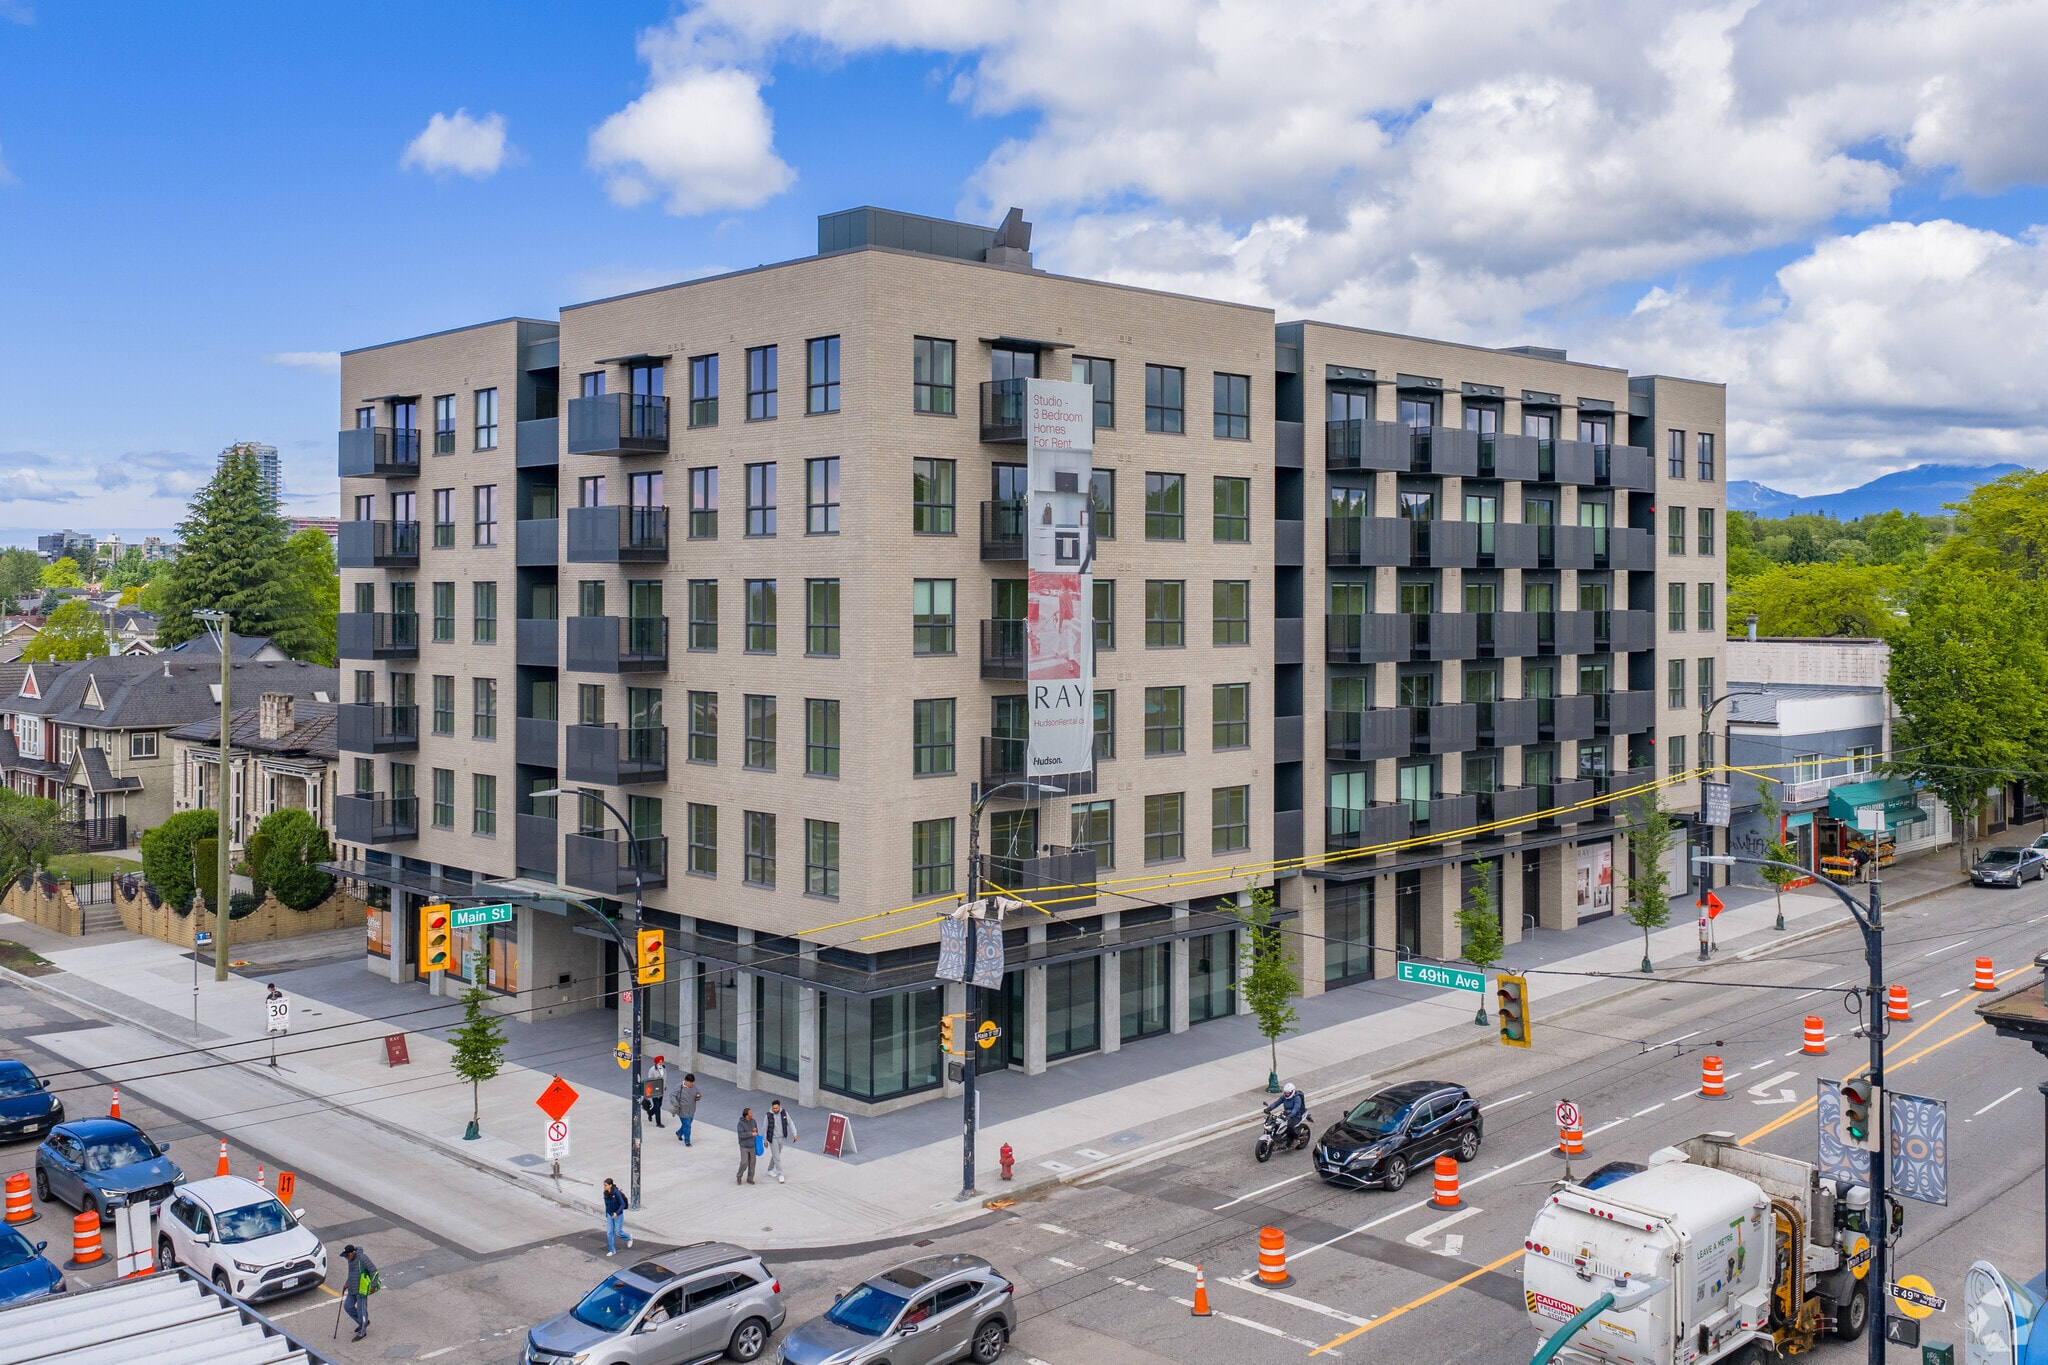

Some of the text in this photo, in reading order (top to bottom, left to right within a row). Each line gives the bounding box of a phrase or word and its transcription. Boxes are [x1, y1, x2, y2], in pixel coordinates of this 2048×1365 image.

[1033, 394, 1063, 407] Studio
[1033, 408, 1083, 422] 3 Bedroom
[1033, 422, 1066, 434] Homes
[1033, 436, 1072, 449] For Rent
[1034, 684, 1086, 709] RAY
[457, 907, 505, 925] Main St
[1404, 965, 1480, 989] E 49th Ave
[270, 1003, 288, 1017] 30
[1696, 1245, 1712, 1260] LEAVE
[1717, 1233, 1733, 1248] METRE
[1893, 1286, 1899, 1296] E
[1536, 1295, 1574, 1313] CAUTION
[1540, 1304, 1573, 1318] FREQUENT
